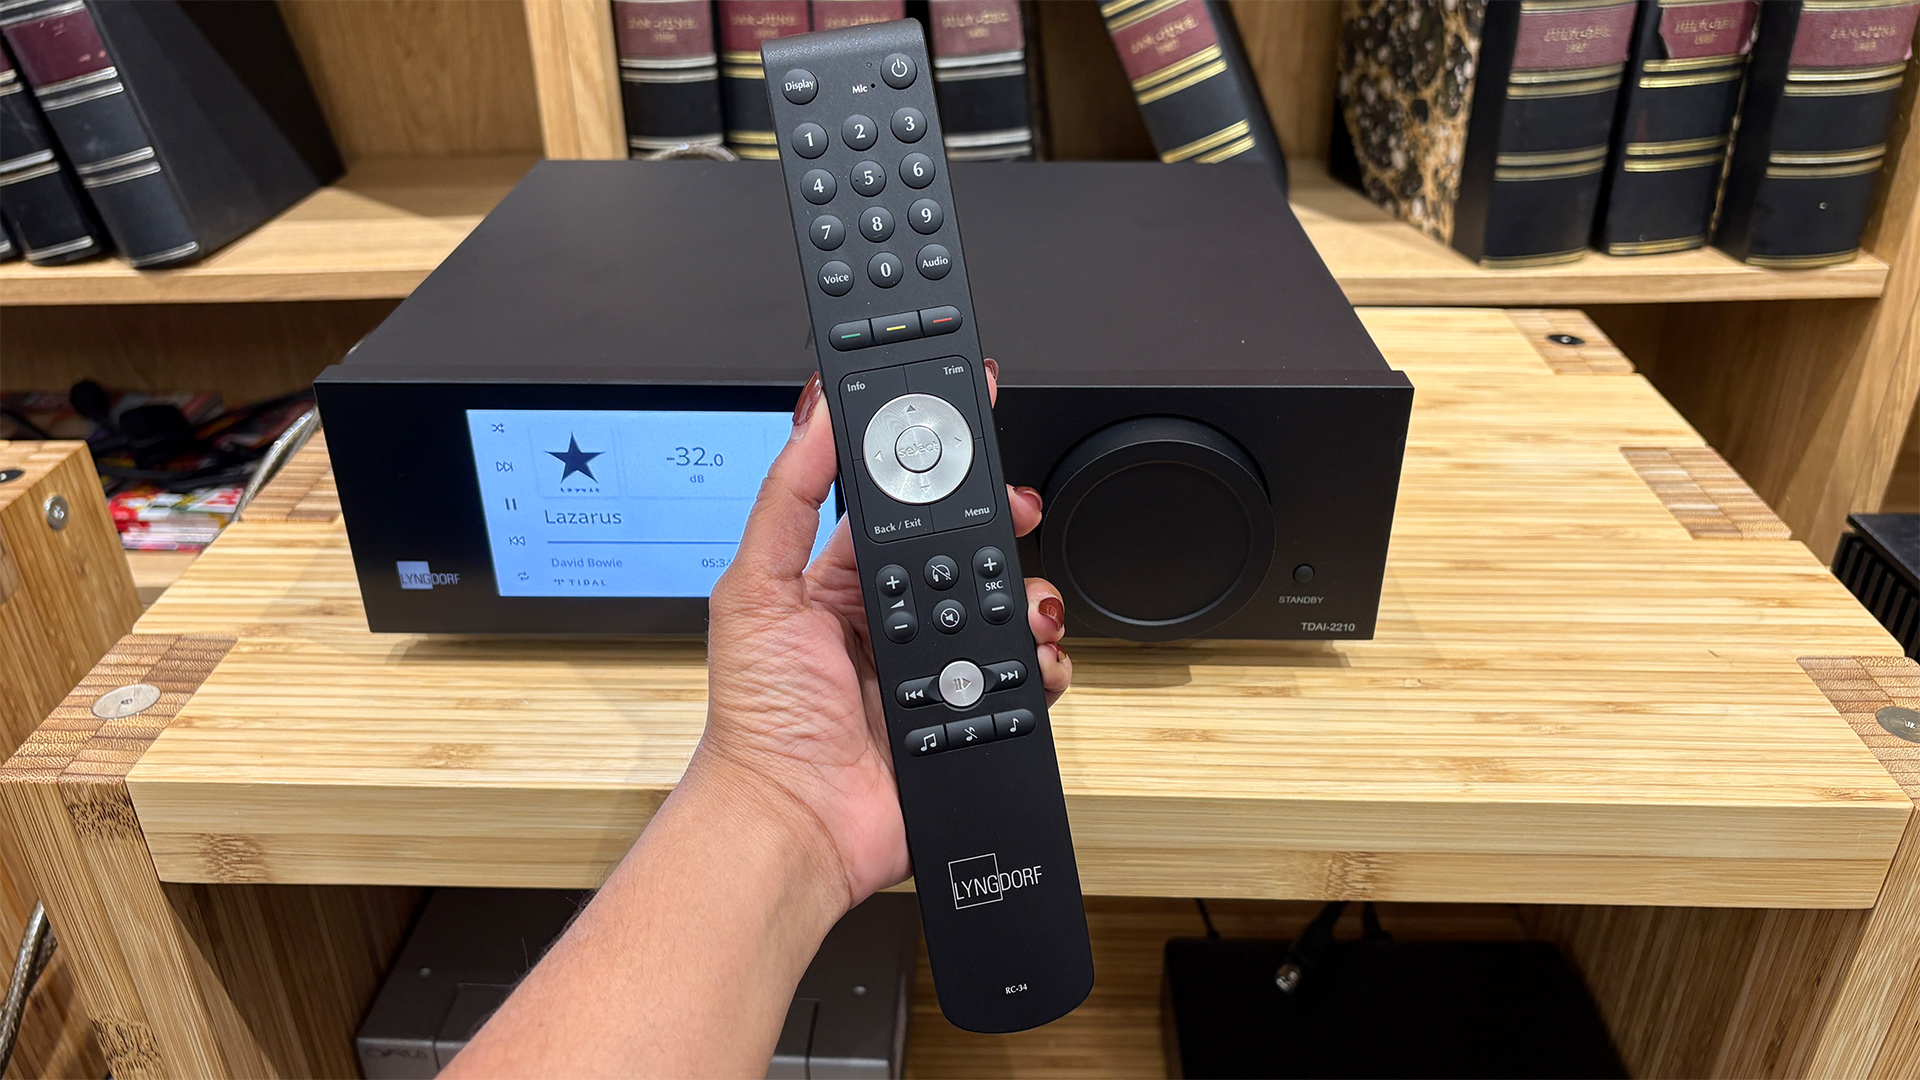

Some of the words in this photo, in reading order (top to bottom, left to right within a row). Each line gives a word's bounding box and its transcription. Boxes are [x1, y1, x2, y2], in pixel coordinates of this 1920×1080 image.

[785, 80, 815, 91] Display
[852, 85, 868, 94] Mic
[904, 116, 915, 132] 3
[854, 124, 866, 139] 2
[805, 132, 814, 147] 1
[913, 162, 924, 177] 6
[863, 170, 874, 185] 5
[813, 178, 824, 193] 4
[921, 208, 932, 224] 9
[872, 216, 883, 231] 8
[821, 225, 832, 240] 7
[921, 256, 949, 268] Audio
[880, 262, 892, 277] 0
[823, 273, 850, 285] Voice
[943, 364, 965, 376] Trim
[847, 381, 866, 392] Info
[899, 440, 940, 458] select
[666, 446, 724, 467] -32.0
[689, 474, 705, 483] dB
[544, 509, 622, 524] Lazarus
[964, 506, 991, 518] Menu
[874, 523, 897, 535] Back
[904, 518, 922, 530] Exit
[551, 557, 584, 568] David
[587, 557, 623, 568] Bowie
[400, 572, 461, 586] LYNGDORF
[568, 579, 607, 587] TIDAL
[985, 580, 1004, 592] SRC
[1278, 595, 1324, 605] STANDBY
[1300, 622, 1356, 632] TDAI-2210
[954, 865, 1043, 900] LYNGDORF
[1005, 983, 1028, 995] RC-34
